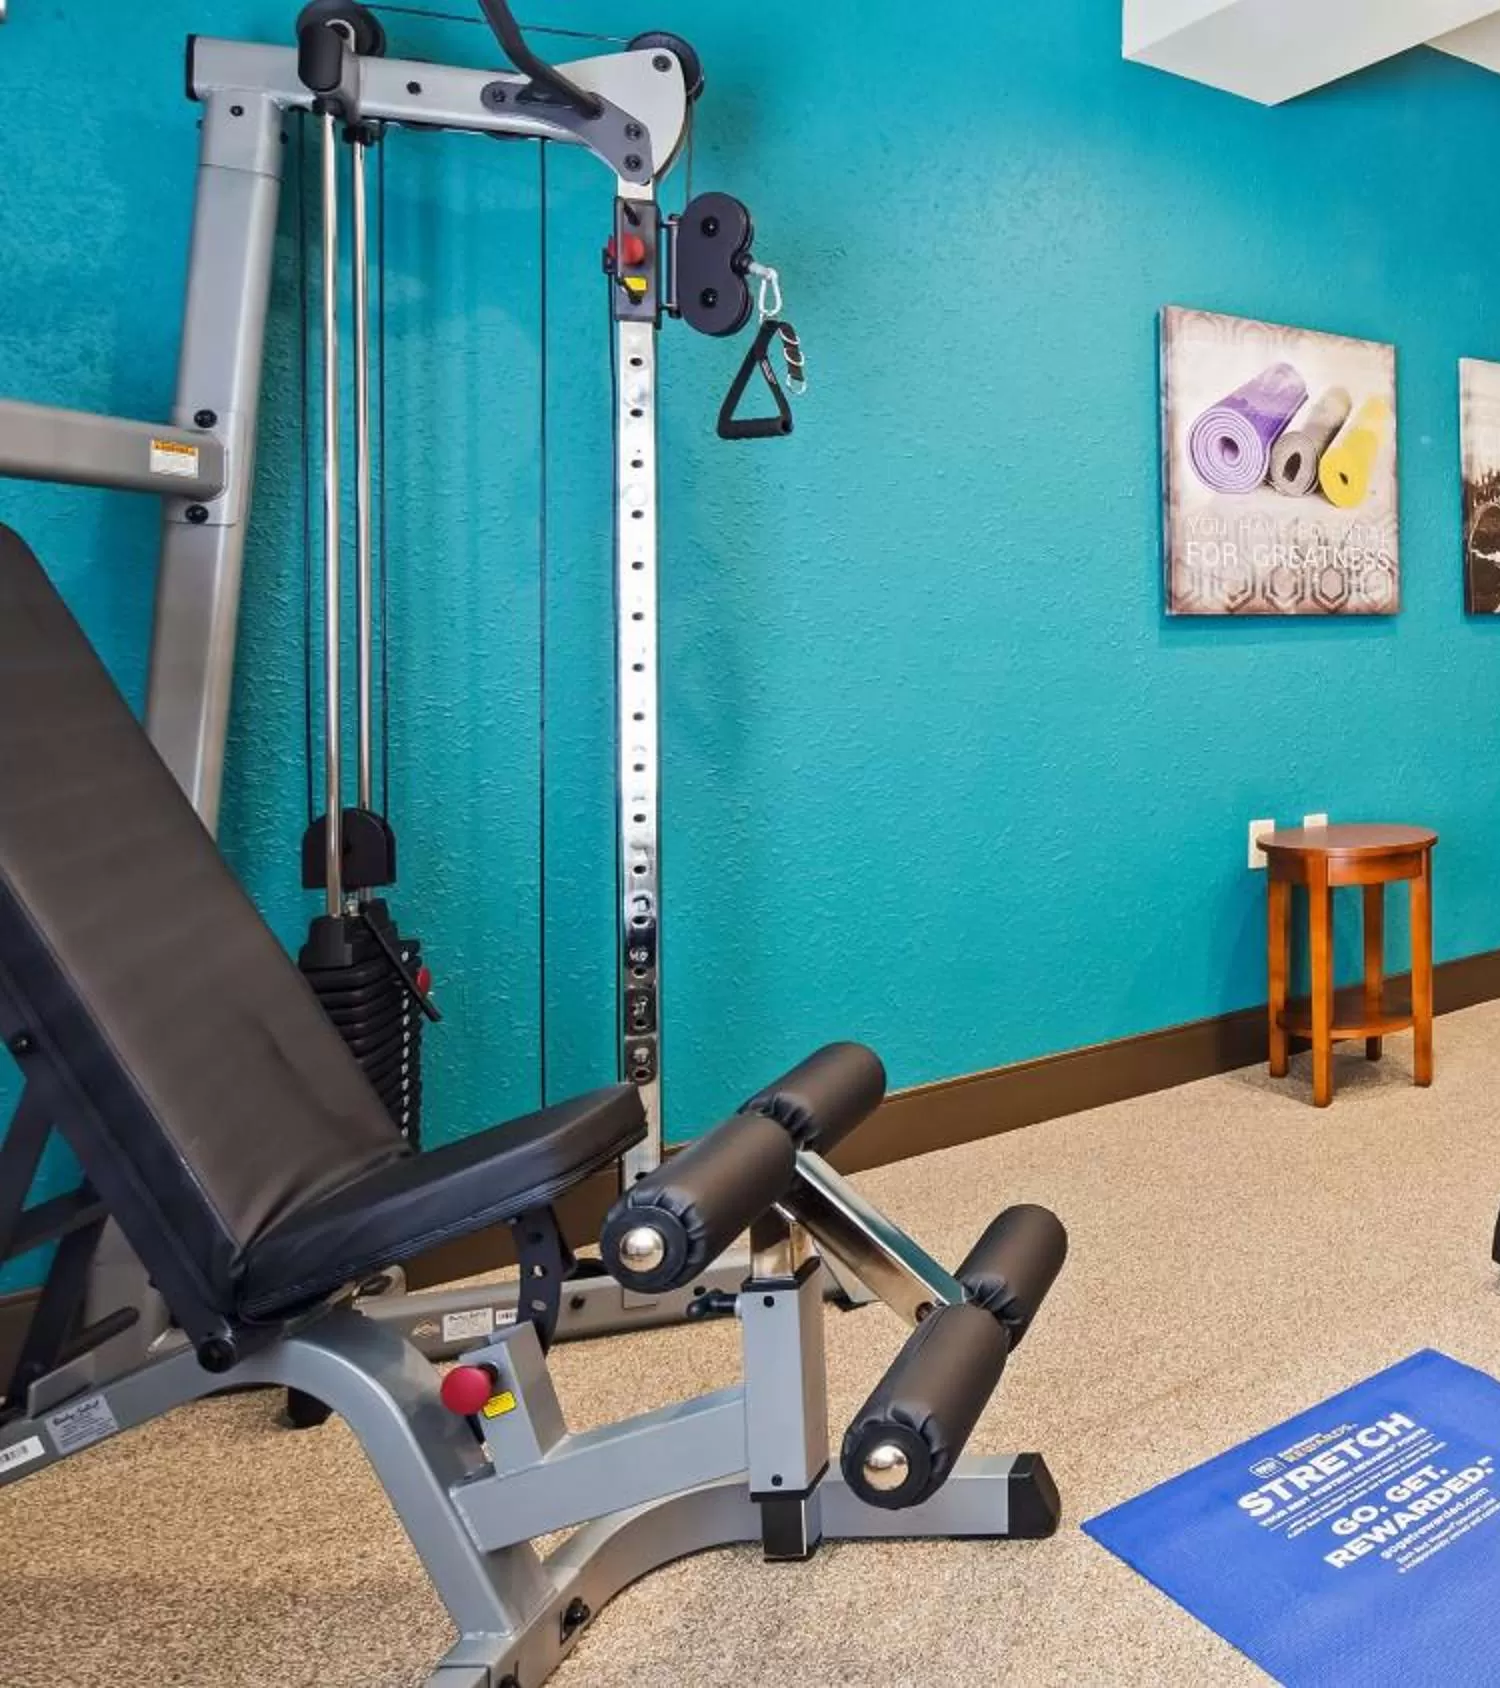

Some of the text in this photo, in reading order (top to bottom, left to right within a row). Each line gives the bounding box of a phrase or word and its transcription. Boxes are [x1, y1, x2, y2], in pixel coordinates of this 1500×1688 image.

[1186, 515, 1228, 537] YOU
[1186, 540, 1391, 571] FOR GREATNESS
[1237, 1411, 1416, 1517] STRETCH
[1331, 1504, 1389, 1536] GO.
[1385, 1464, 1449, 1503] GET.
[1380, 1487, 1490, 1560] gogetrewarded.com
